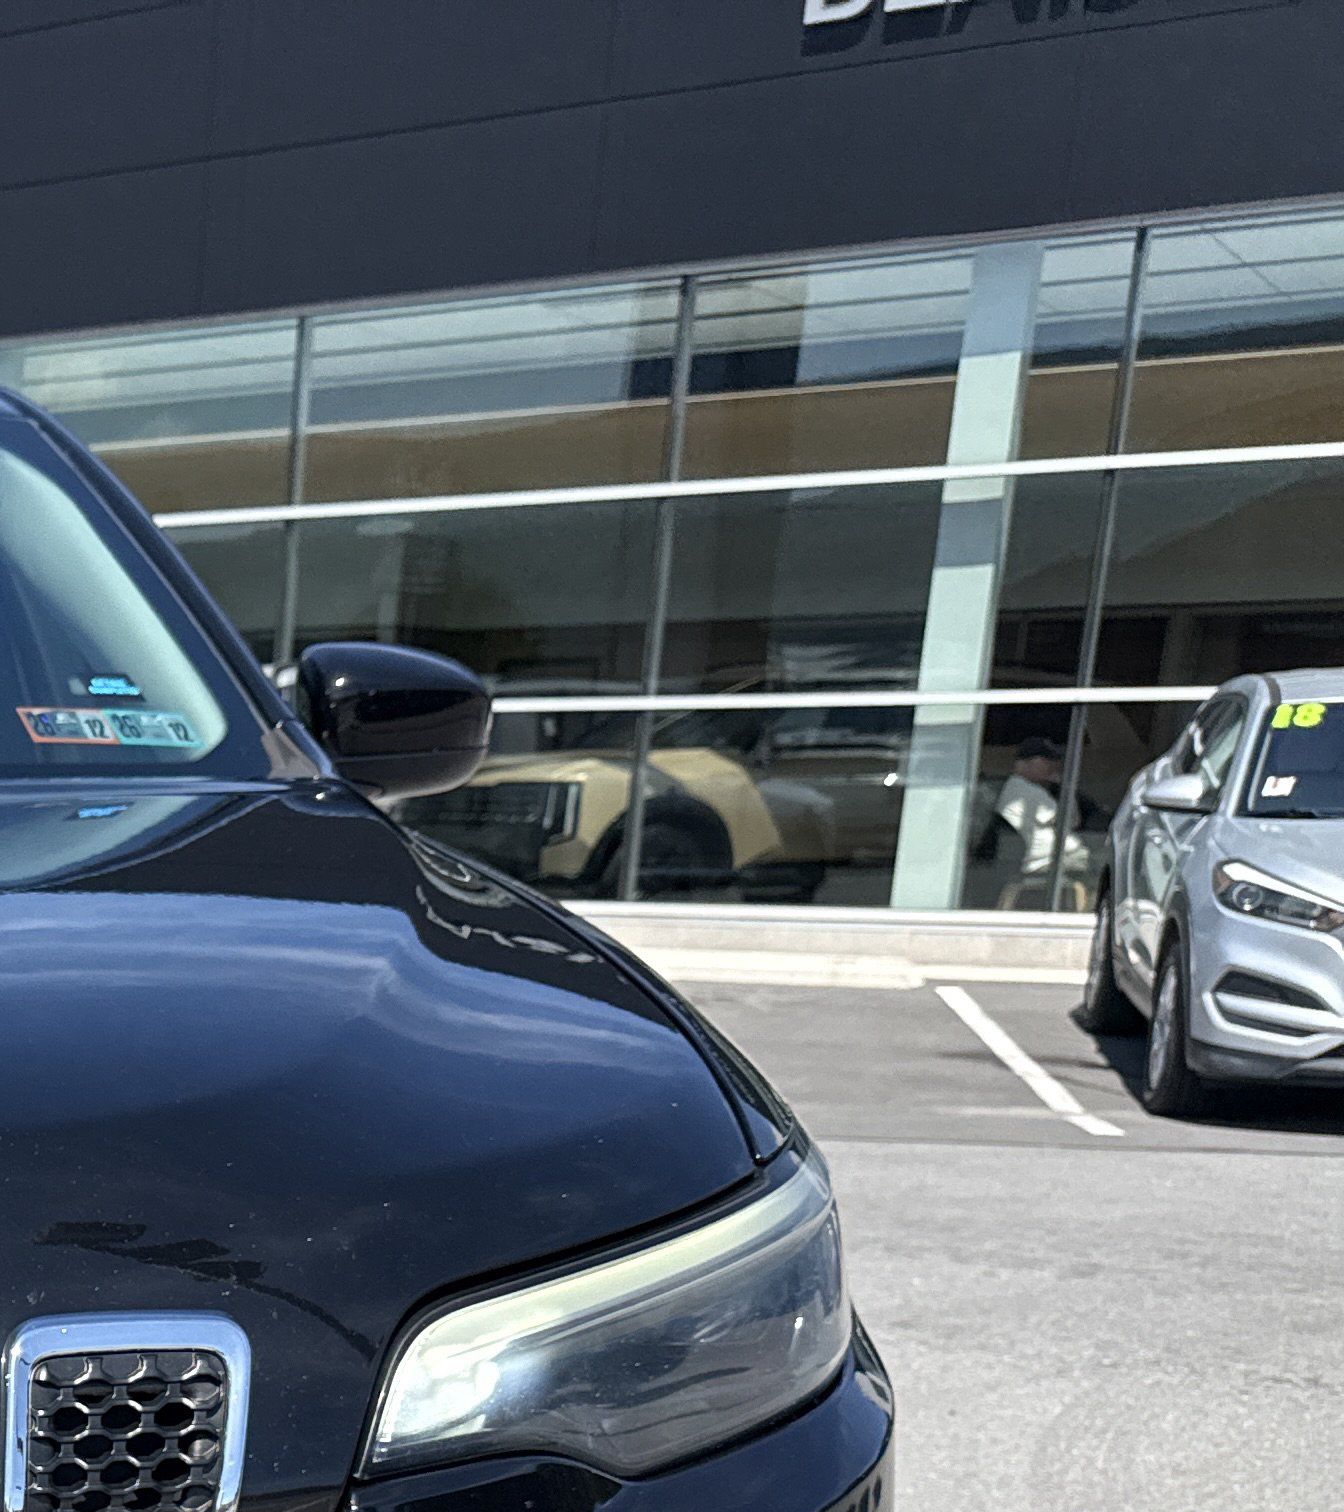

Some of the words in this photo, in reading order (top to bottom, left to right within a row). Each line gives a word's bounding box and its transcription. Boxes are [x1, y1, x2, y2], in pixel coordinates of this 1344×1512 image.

[1272, 703, 1326, 728] 18
[85, 719, 110, 739] 12
[168, 721, 195, 743] 12
